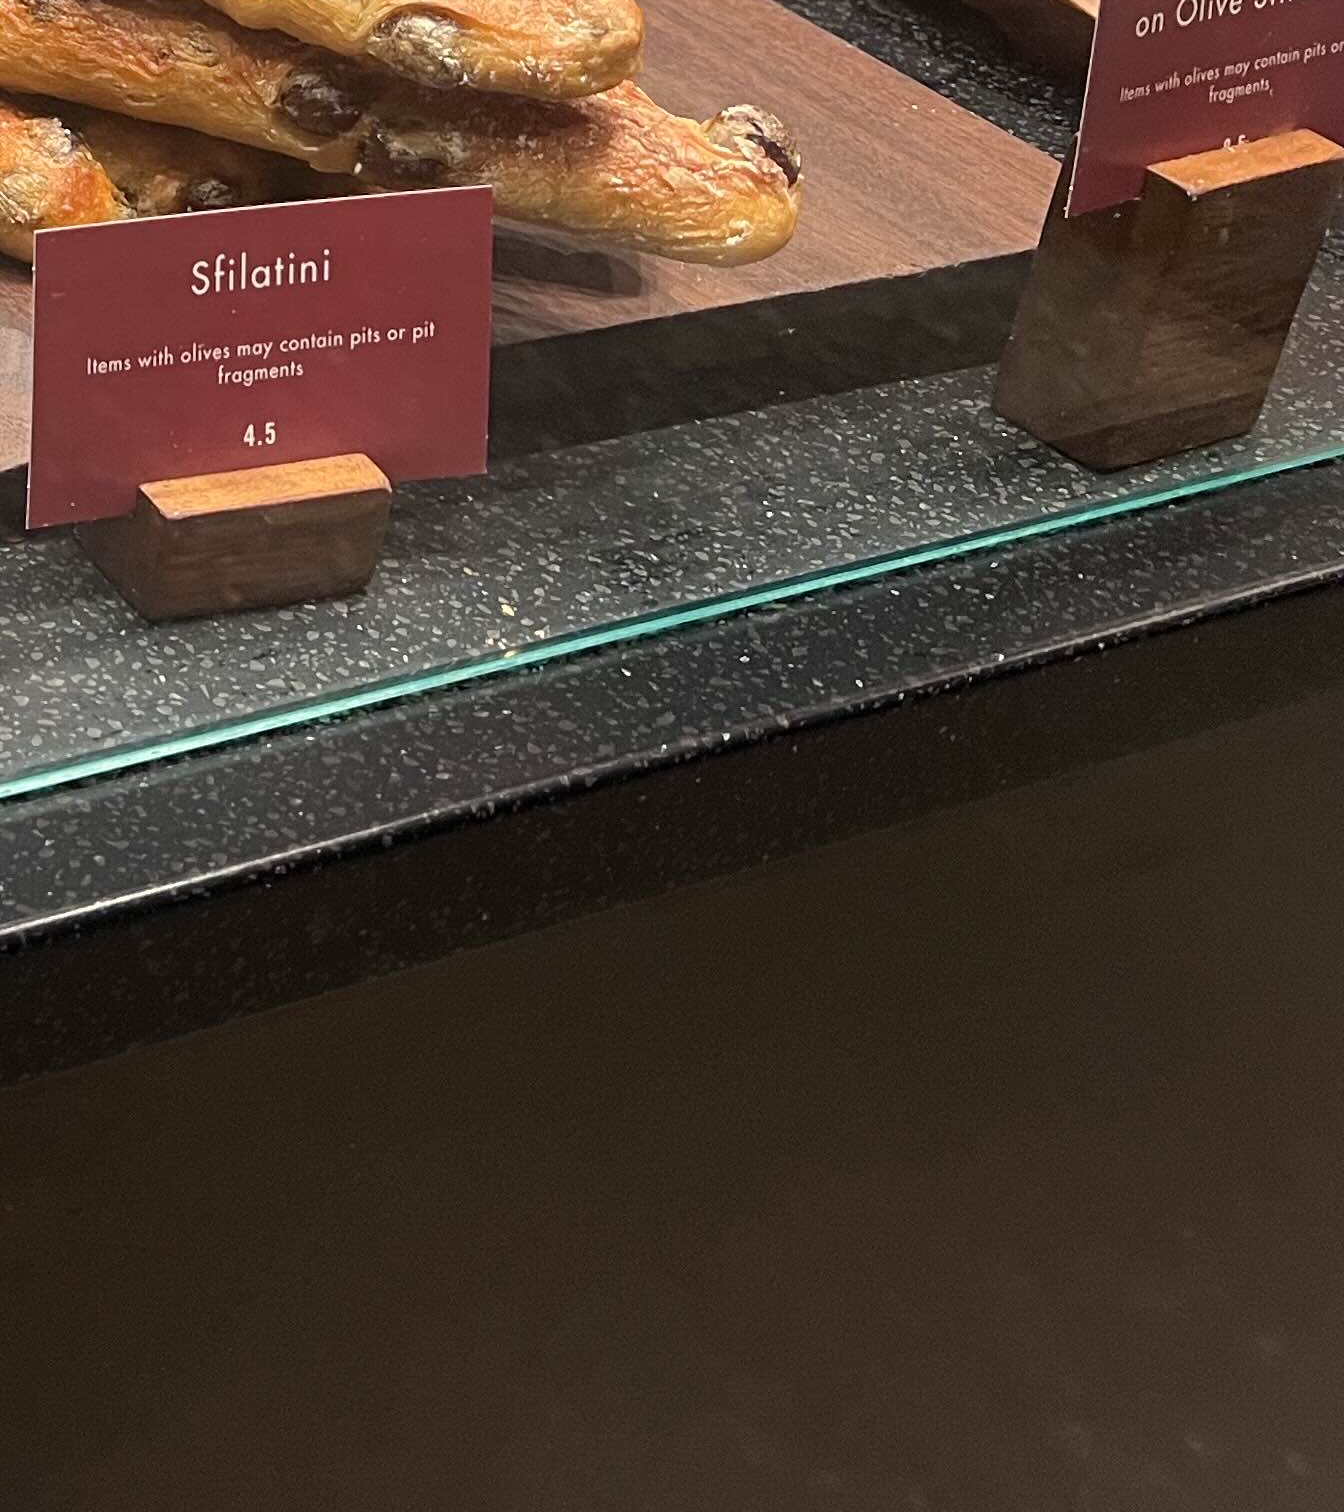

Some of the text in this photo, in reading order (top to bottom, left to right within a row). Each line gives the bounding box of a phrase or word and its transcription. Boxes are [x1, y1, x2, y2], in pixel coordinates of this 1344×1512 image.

[1135, 11, 1165, 38] on
[1119, 84, 1151, 102] Items
[1154, 71, 1181, 92] with
[1184, 66, 1220, 87] olives
[1223, 61, 1251, 78] may
[1254, 50, 1301, 71] contain
[1303, 42, 1327, 64] pits
[1208, 78, 1271, 104] fragments
[191, 248, 332, 296] Sfilatini
[87, 320, 435, 375] Items with olives may contain pits or pit
[217, 359, 304, 387] fragments
[243, 421, 276, 447] 4.5
